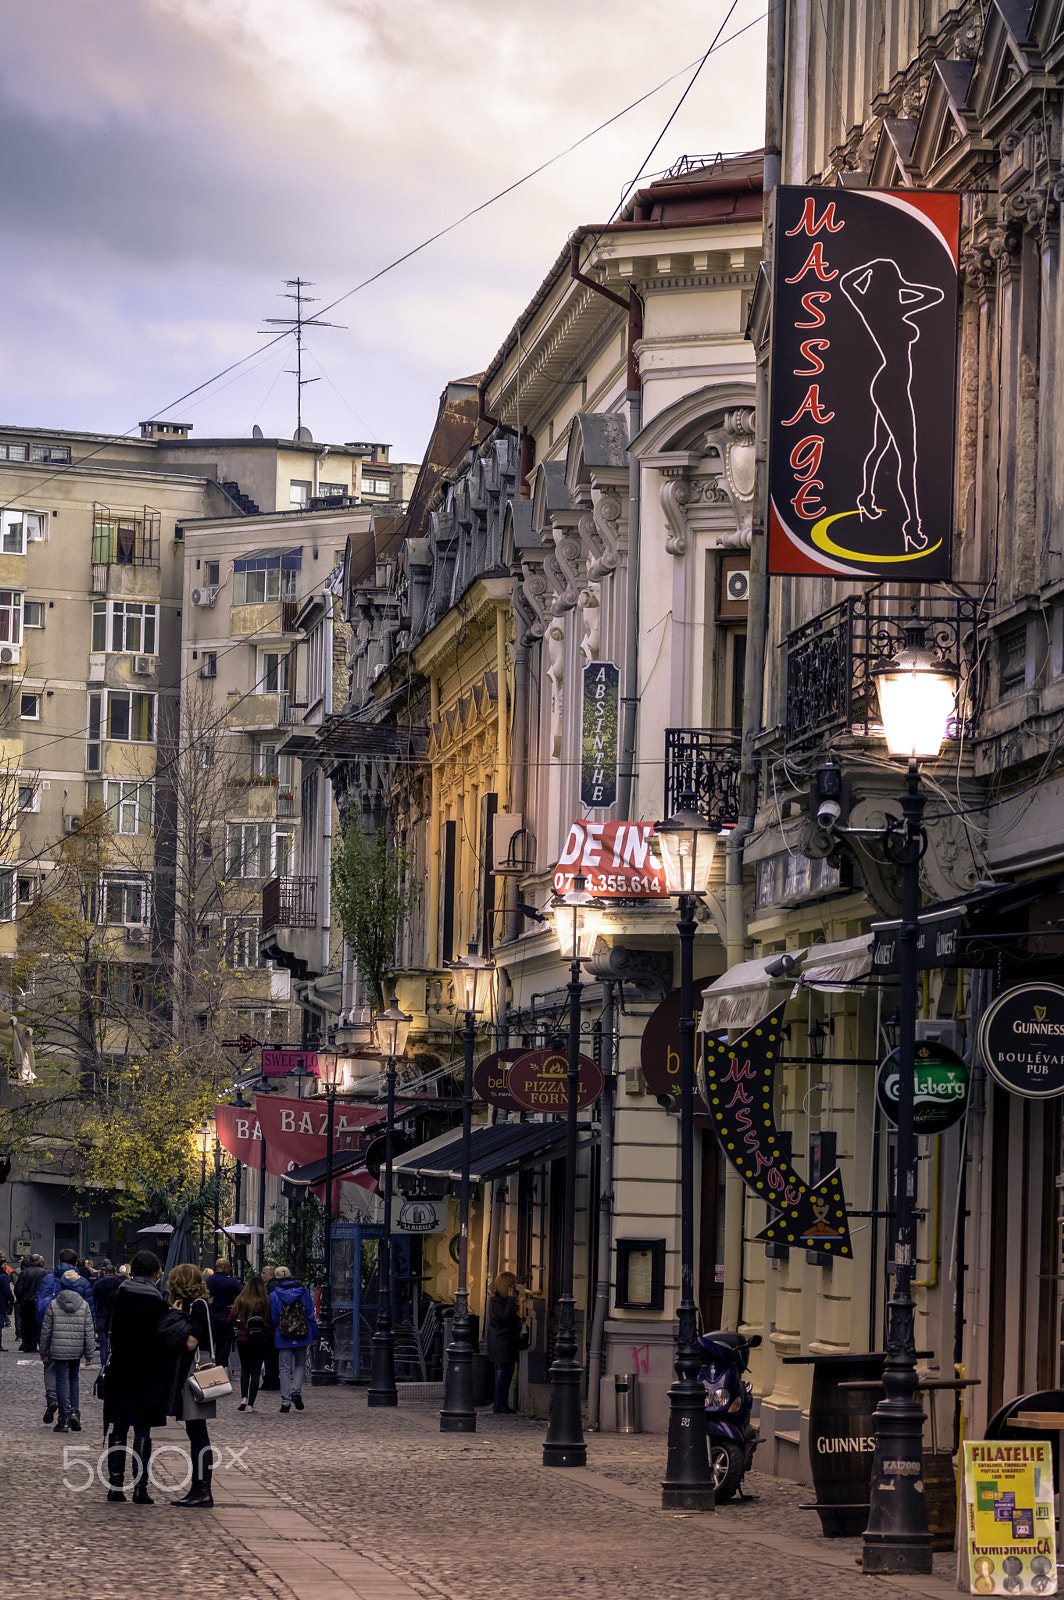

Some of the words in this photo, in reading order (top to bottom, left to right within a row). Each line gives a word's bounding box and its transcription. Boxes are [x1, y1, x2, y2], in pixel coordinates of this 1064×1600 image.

[781, 196, 845, 520] MASSAGE
[591, 667, 606, 801] ABSINTHE
[558, 823, 604, 867] DE
[612, 826, 663, 870] IN
[554, 872, 661, 894] 074.355.614
[1026, 1064, 1049, 1074] PUB
[524, 1081, 566, 1093] PIZZA
[885, 1073, 966, 1100] Clsberg
[280, 1109, 370, 1140] BAZA
[720, 1058, 801, 1204] MASSAGE
[817, 1436, 878, 1453] GUINNES
[972, 1446, 1044, 1461] FILATELIE
